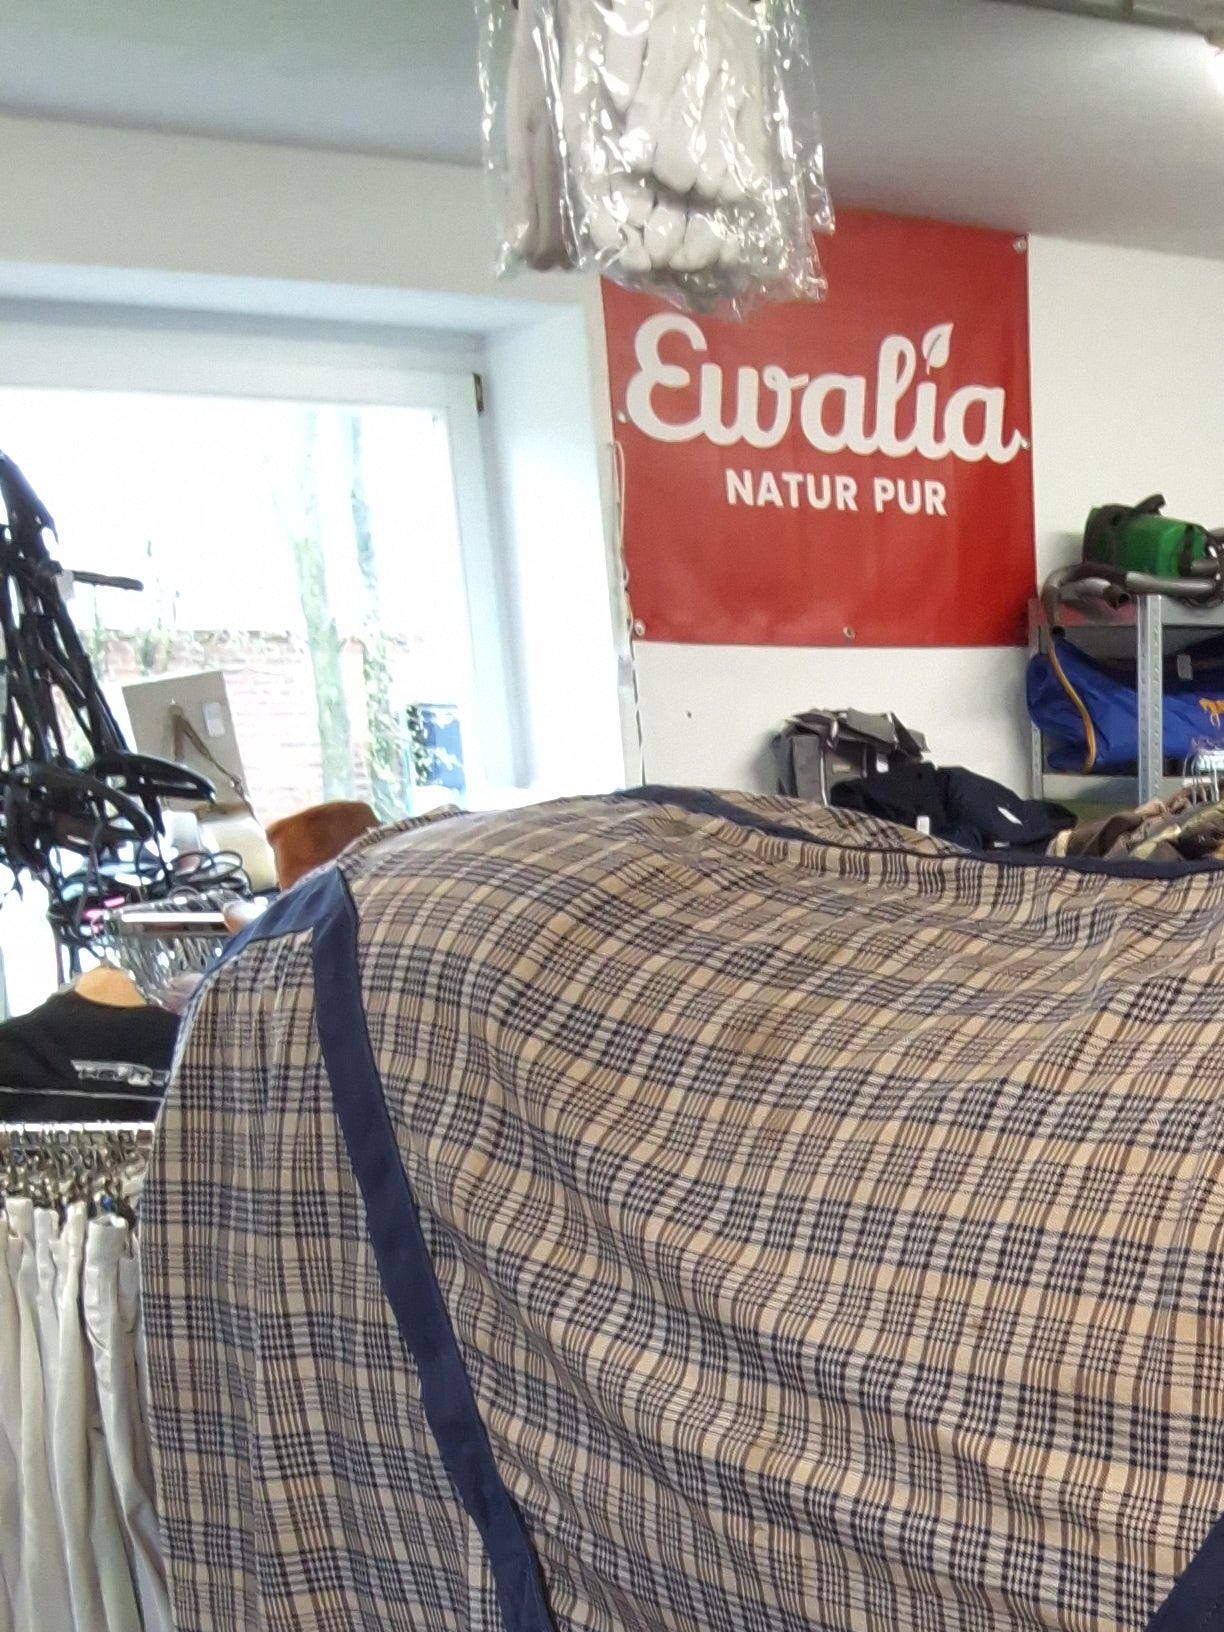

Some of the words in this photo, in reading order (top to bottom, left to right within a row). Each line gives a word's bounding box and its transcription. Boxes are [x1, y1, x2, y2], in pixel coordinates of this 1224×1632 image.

[625, 312, 1021, 463] Ewalia
[725, 468, 858, 512] NATUR
[873, 478, 947, 516] PUR
